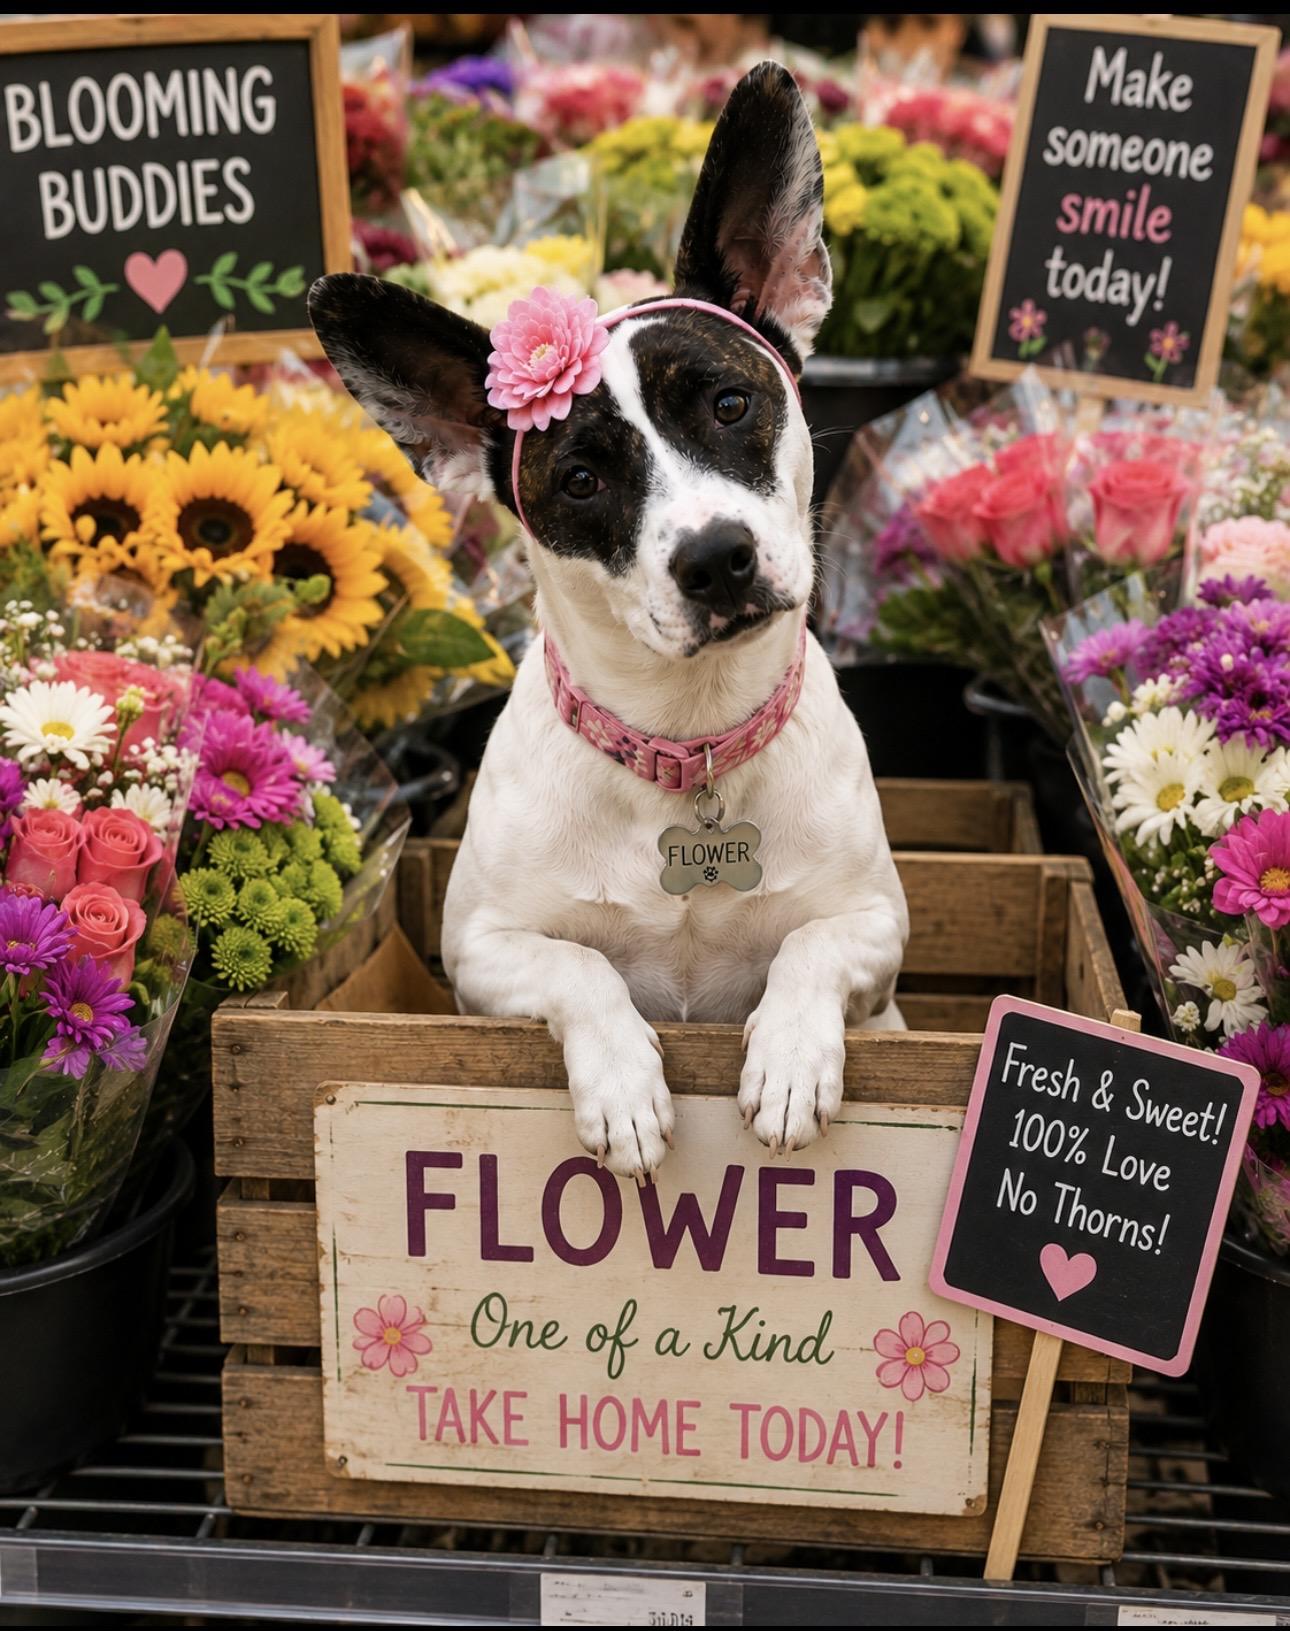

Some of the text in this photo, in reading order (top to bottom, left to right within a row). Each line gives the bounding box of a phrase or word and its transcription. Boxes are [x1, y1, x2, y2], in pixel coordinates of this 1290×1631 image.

[4, 65, 277, 153] BLOOMING
[1084, 45, 1194, 112] Make
[1042, 126, 1214, 182] someone
[38, 156, 255, 240] BUDDIES
[1056, 183, 1173, 244] smile
[1045, 245, 1173, 327] today!
[667, 841, 751, 867] FLOWER
[1000, 1041, 1228, 1145] Fresh & Sweet!
[1009, 1108, 1171, 1191] 100% Love
[405, 1150, 901, 1281] FLOWER
[996, 1167, 1171, 1255] No Thorns!
[470, 1291, 834, 1379] One of a Kind
[406, 1385, 905, 1470] TAKE HOME TODAY!
